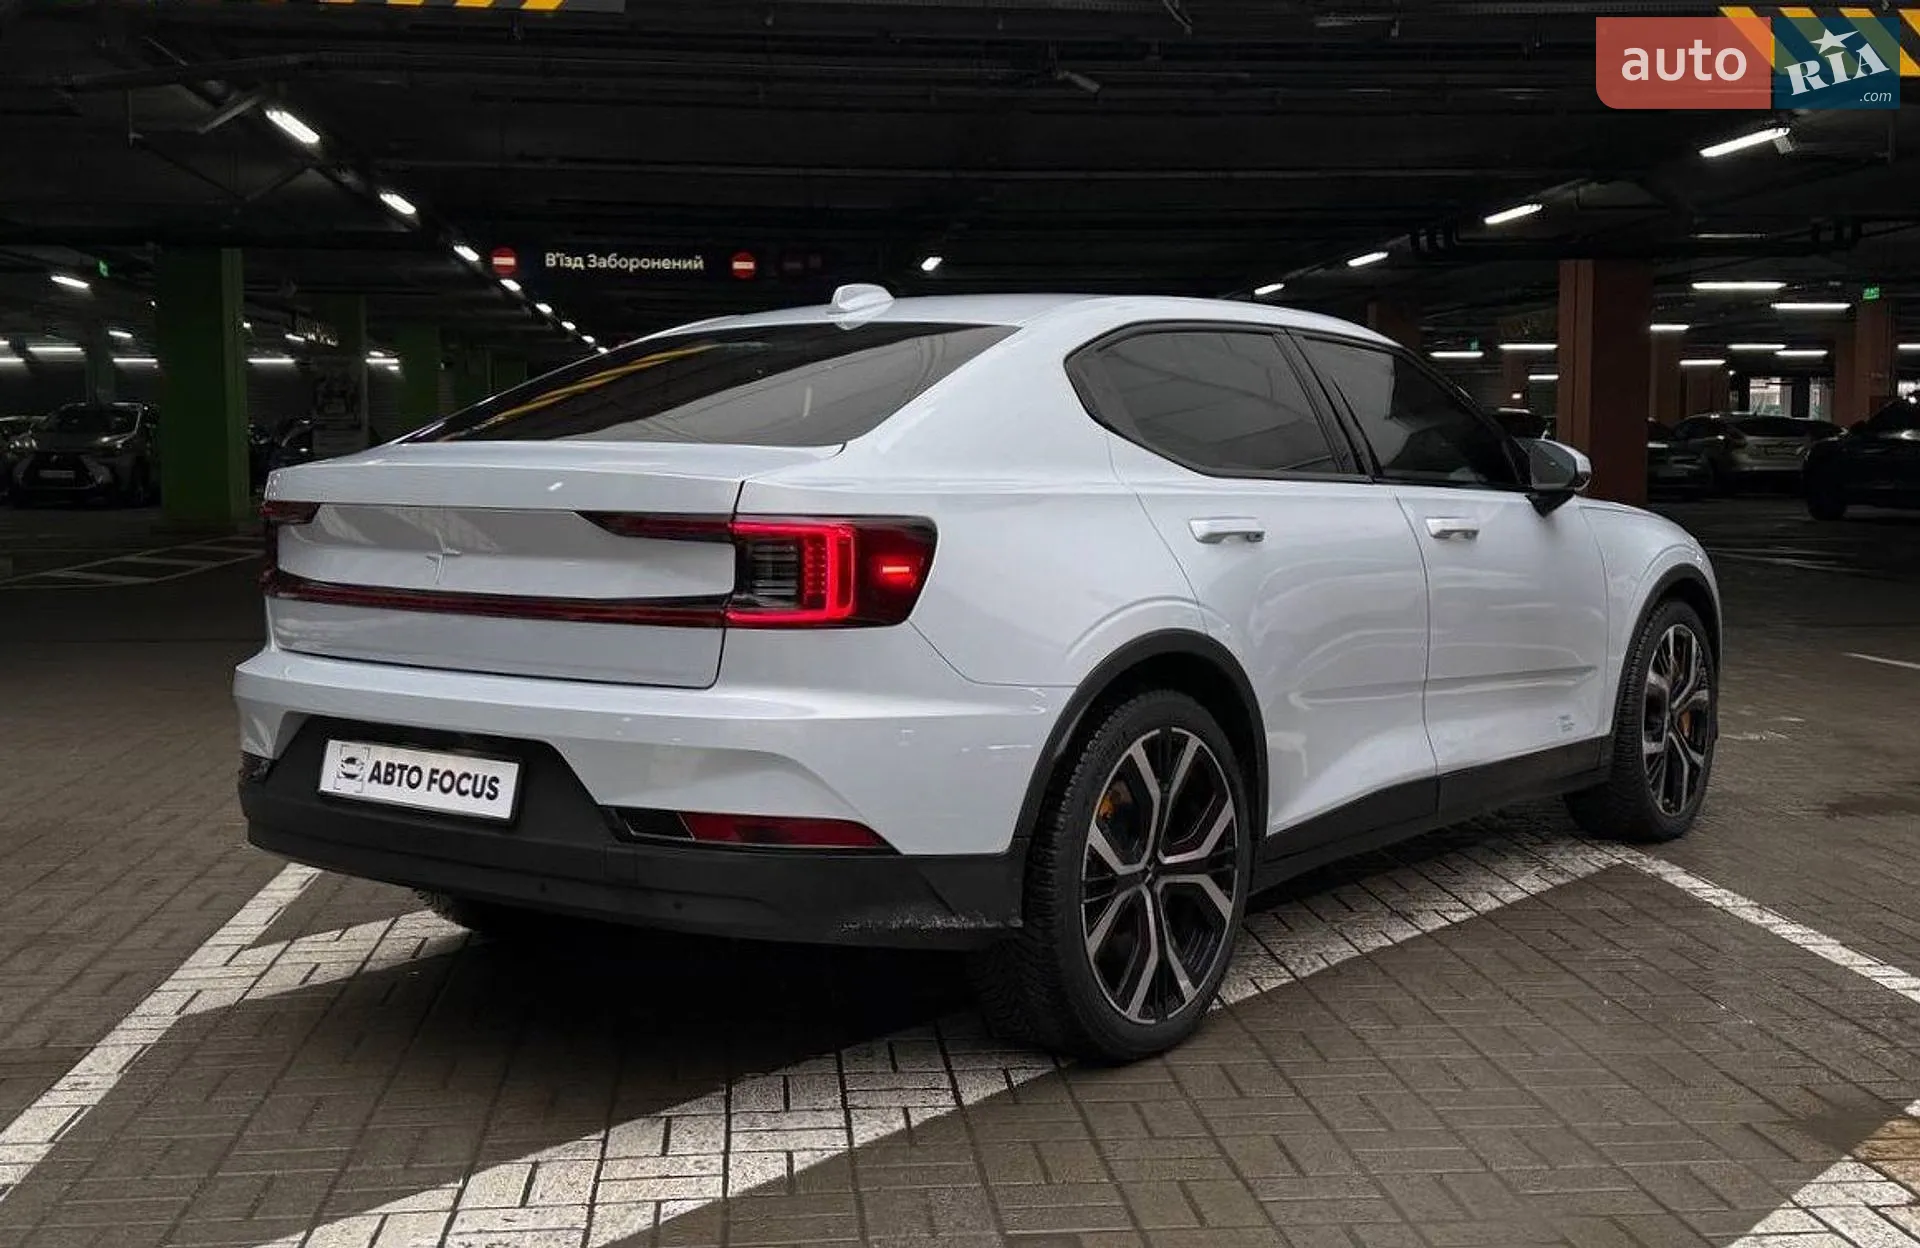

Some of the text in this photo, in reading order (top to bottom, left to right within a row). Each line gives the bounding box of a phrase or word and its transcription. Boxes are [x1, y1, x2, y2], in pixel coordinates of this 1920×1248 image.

[544, 252, 705, 272] В'їзд Заборонений
[426, 767, 500, 801] FOCUS
